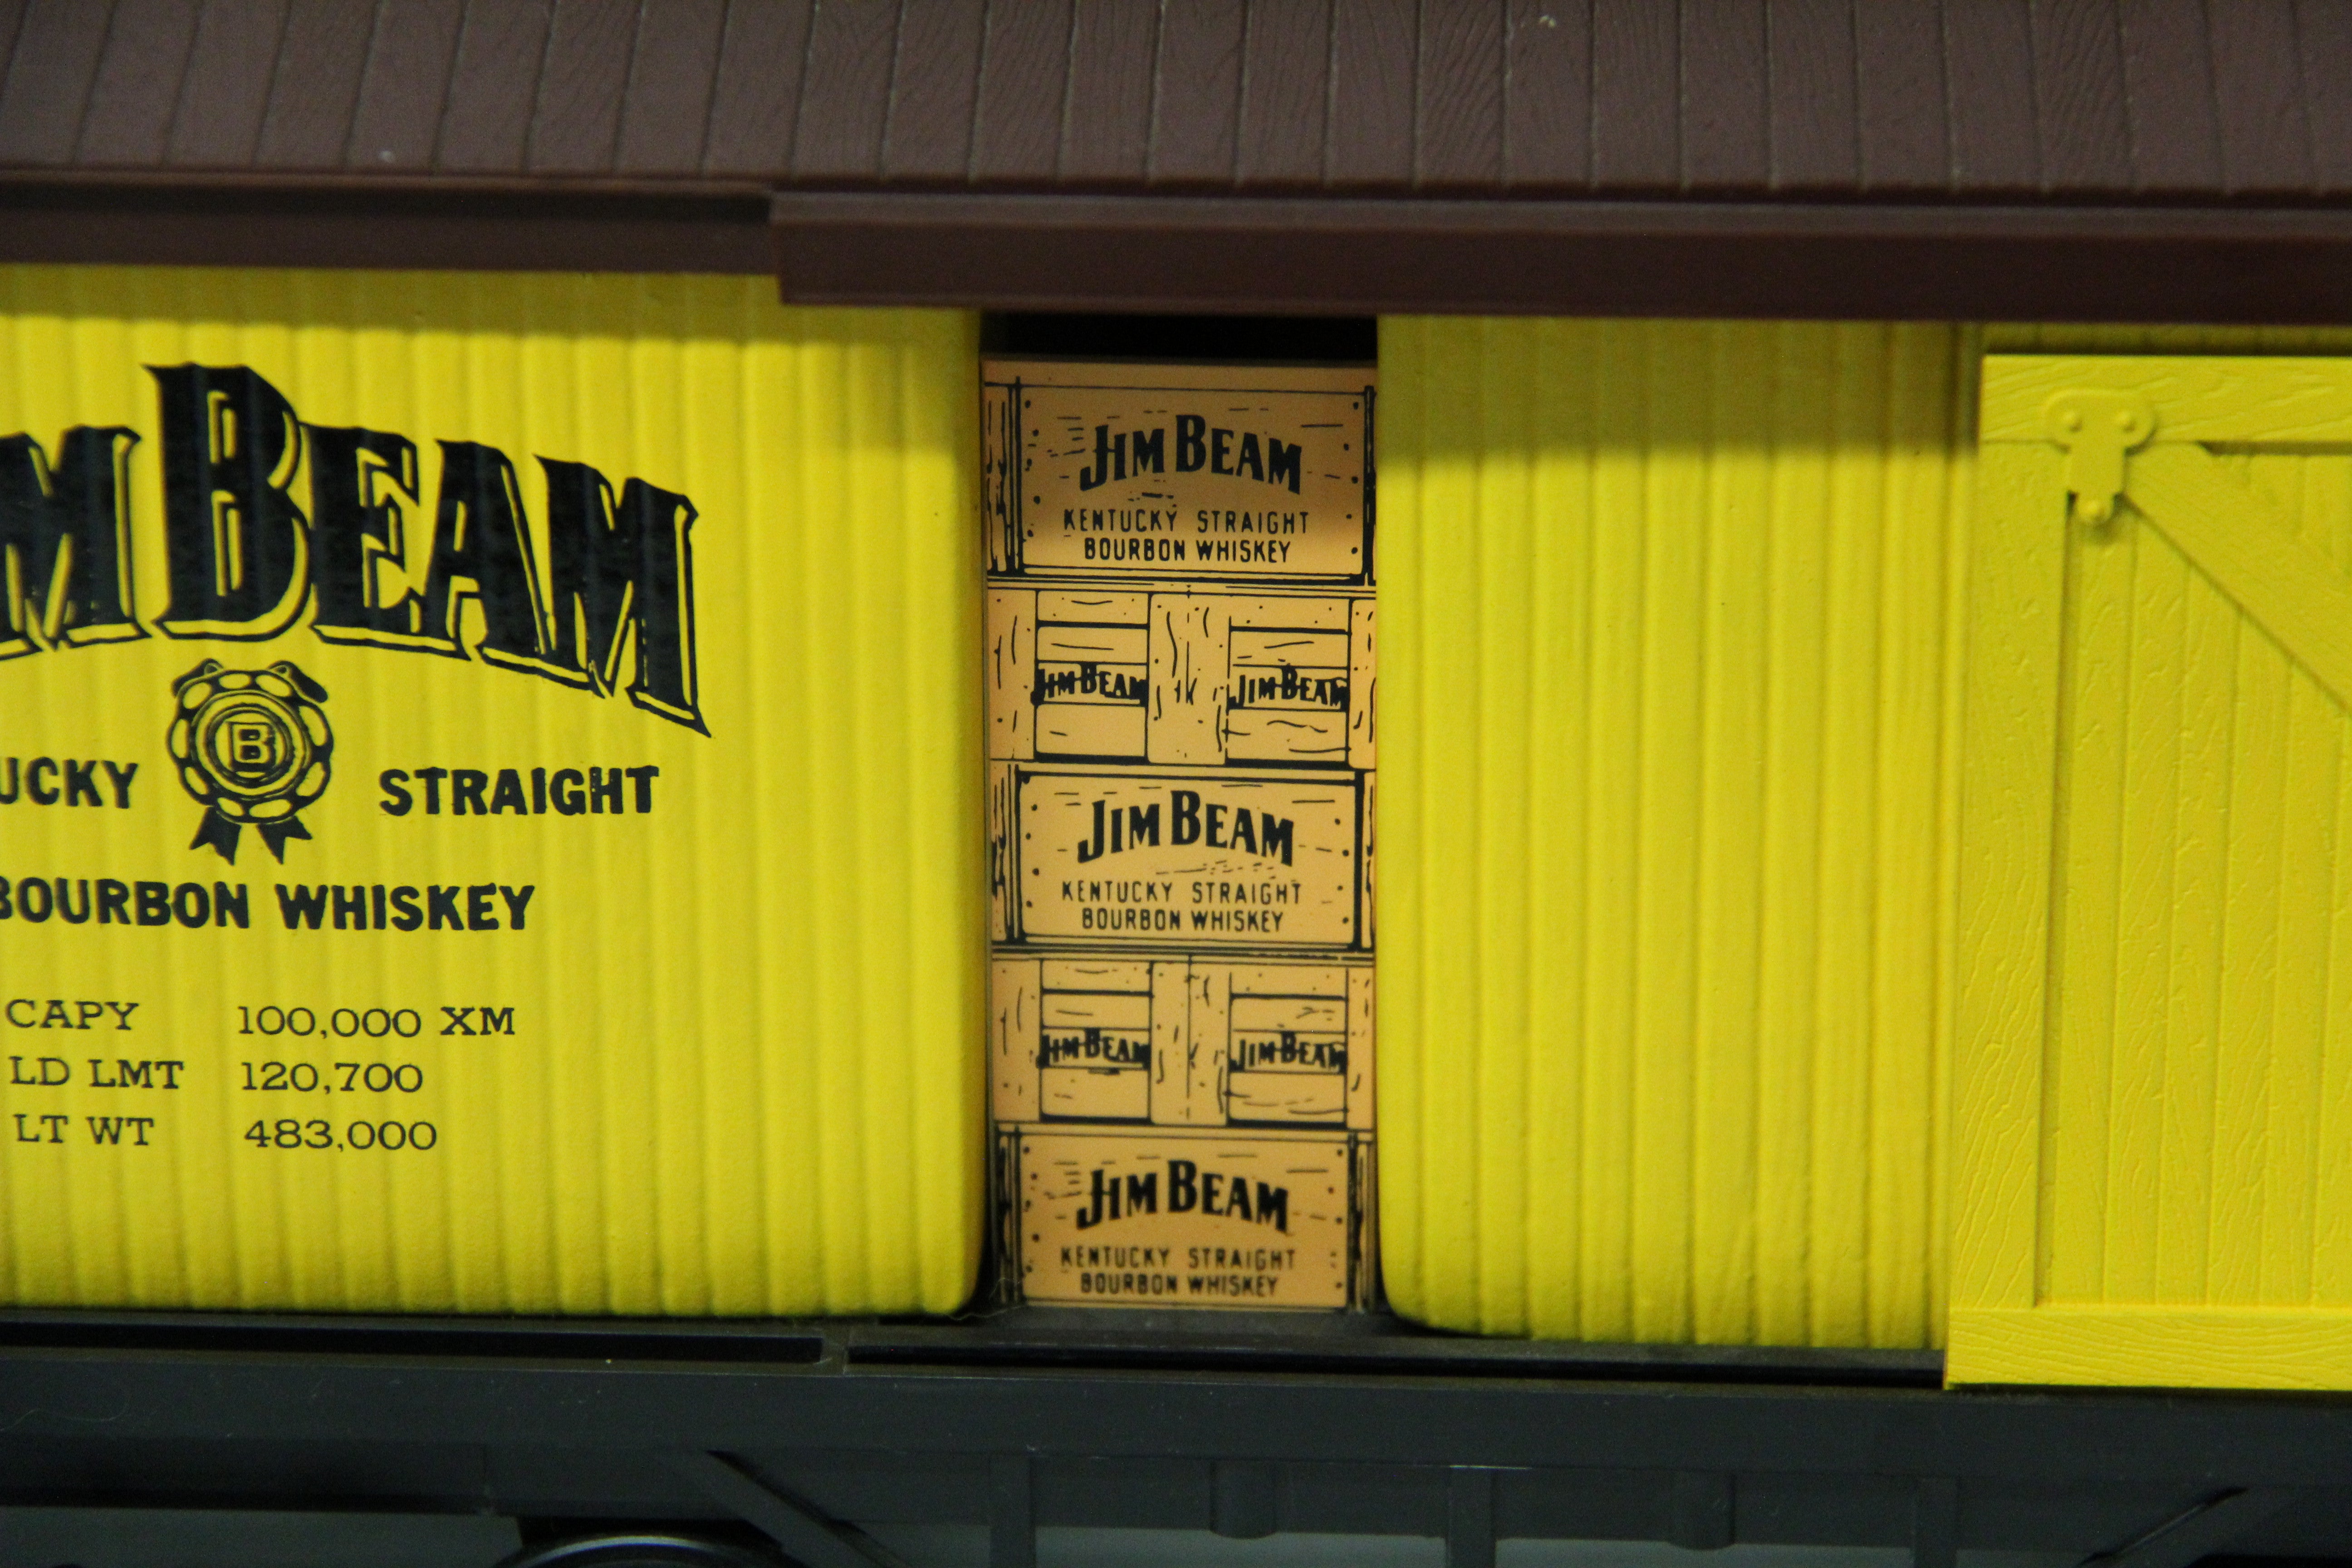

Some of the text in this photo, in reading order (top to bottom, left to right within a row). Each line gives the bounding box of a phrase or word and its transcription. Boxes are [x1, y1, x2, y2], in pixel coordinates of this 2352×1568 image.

[1079, 415, 1302, 495] JIM BEAM
[1064, 509, 1308, 534] KENTUCKY STRAIGHT
[140, 362, 712, 738] BEAM
[1085, 538, 1290, 563] BOURBON WHISKEY
[380, 765, 659, 816] STRAIGHT
[1078, 790, 1294, 866] JIM BEAM
[275, 883, 535, 931] WHISKEY
[1063, 881, 1300, 905] KENTUCKY STRAIGHT
[1083, 908, 1283, 932] BOURBON WHISKEY
[7, 999, 515, 1039] CAPY 100,000 XM
[10, 1056, 423, 1094] LD LMT 120,700
[14, 1114, 436, 1151] LT WT 483,000
[1076, 1160, 1288, 1233] JIM BEAM
[1061, 1246, 1294, 1271] KENTUCKY STRAIGHT
[1082, 1273, 1276, 1296] BOURBON WHISKEY
